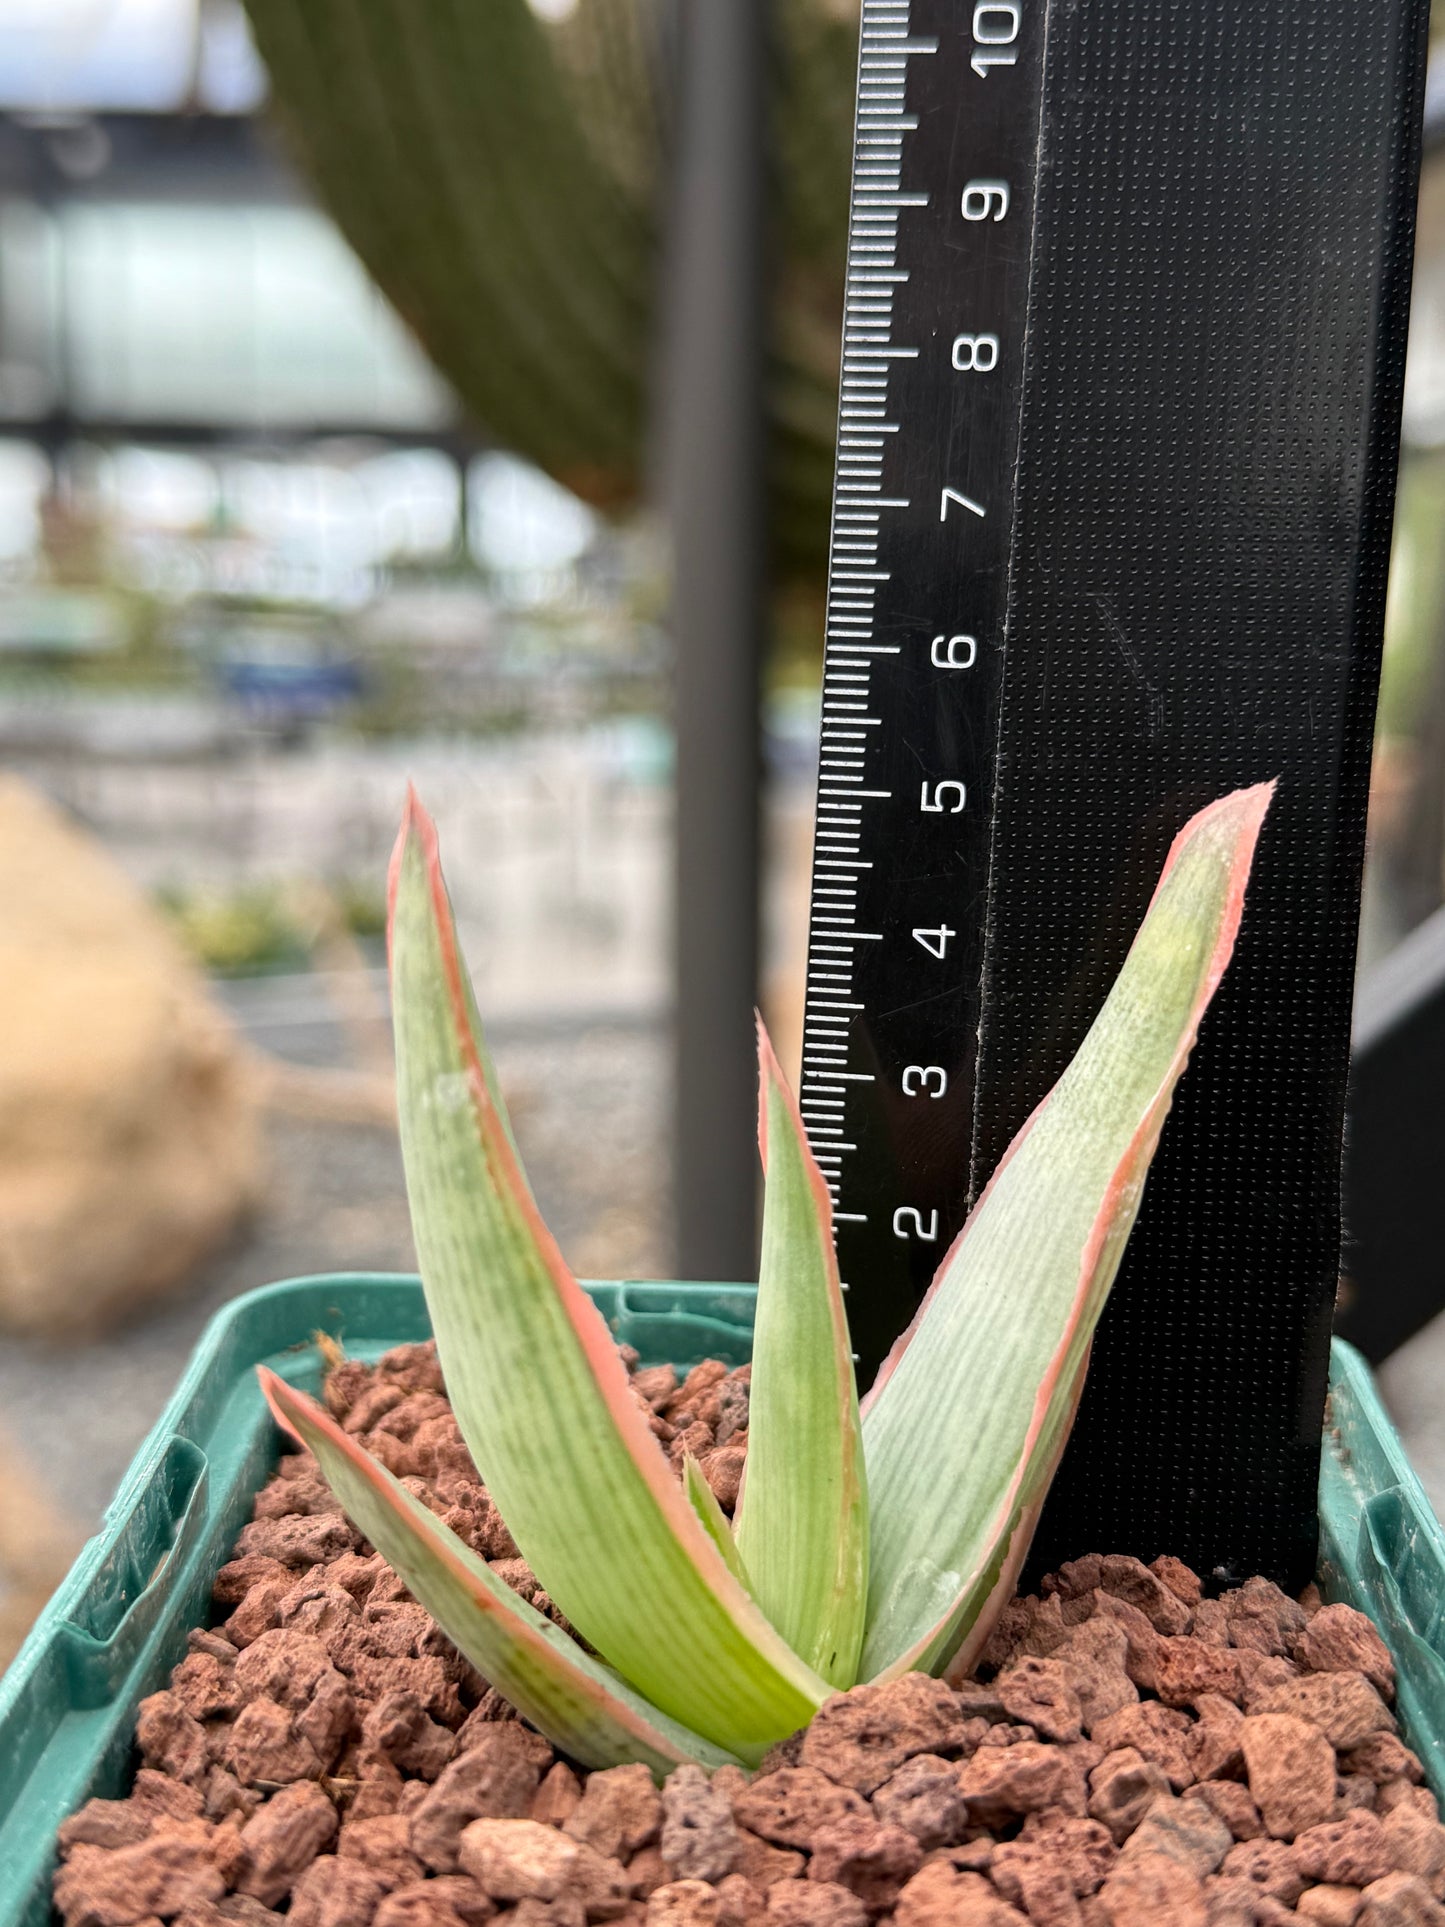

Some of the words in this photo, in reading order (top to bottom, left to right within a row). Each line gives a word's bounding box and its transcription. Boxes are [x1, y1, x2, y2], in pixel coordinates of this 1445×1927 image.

[970, 3, 1019, 79] 10
[961, 182, 1007, 222] 9
[951, 334, 999, 372] 8
[940, 487, 986, 522] 7
[930, 634, 977, 670] 6
[920, 780, 966, 814] 5
[911, 923, 957, 960] 4
[901, 1065, 947, 1099] 3
[892, 1206, 938, 1241] 2
